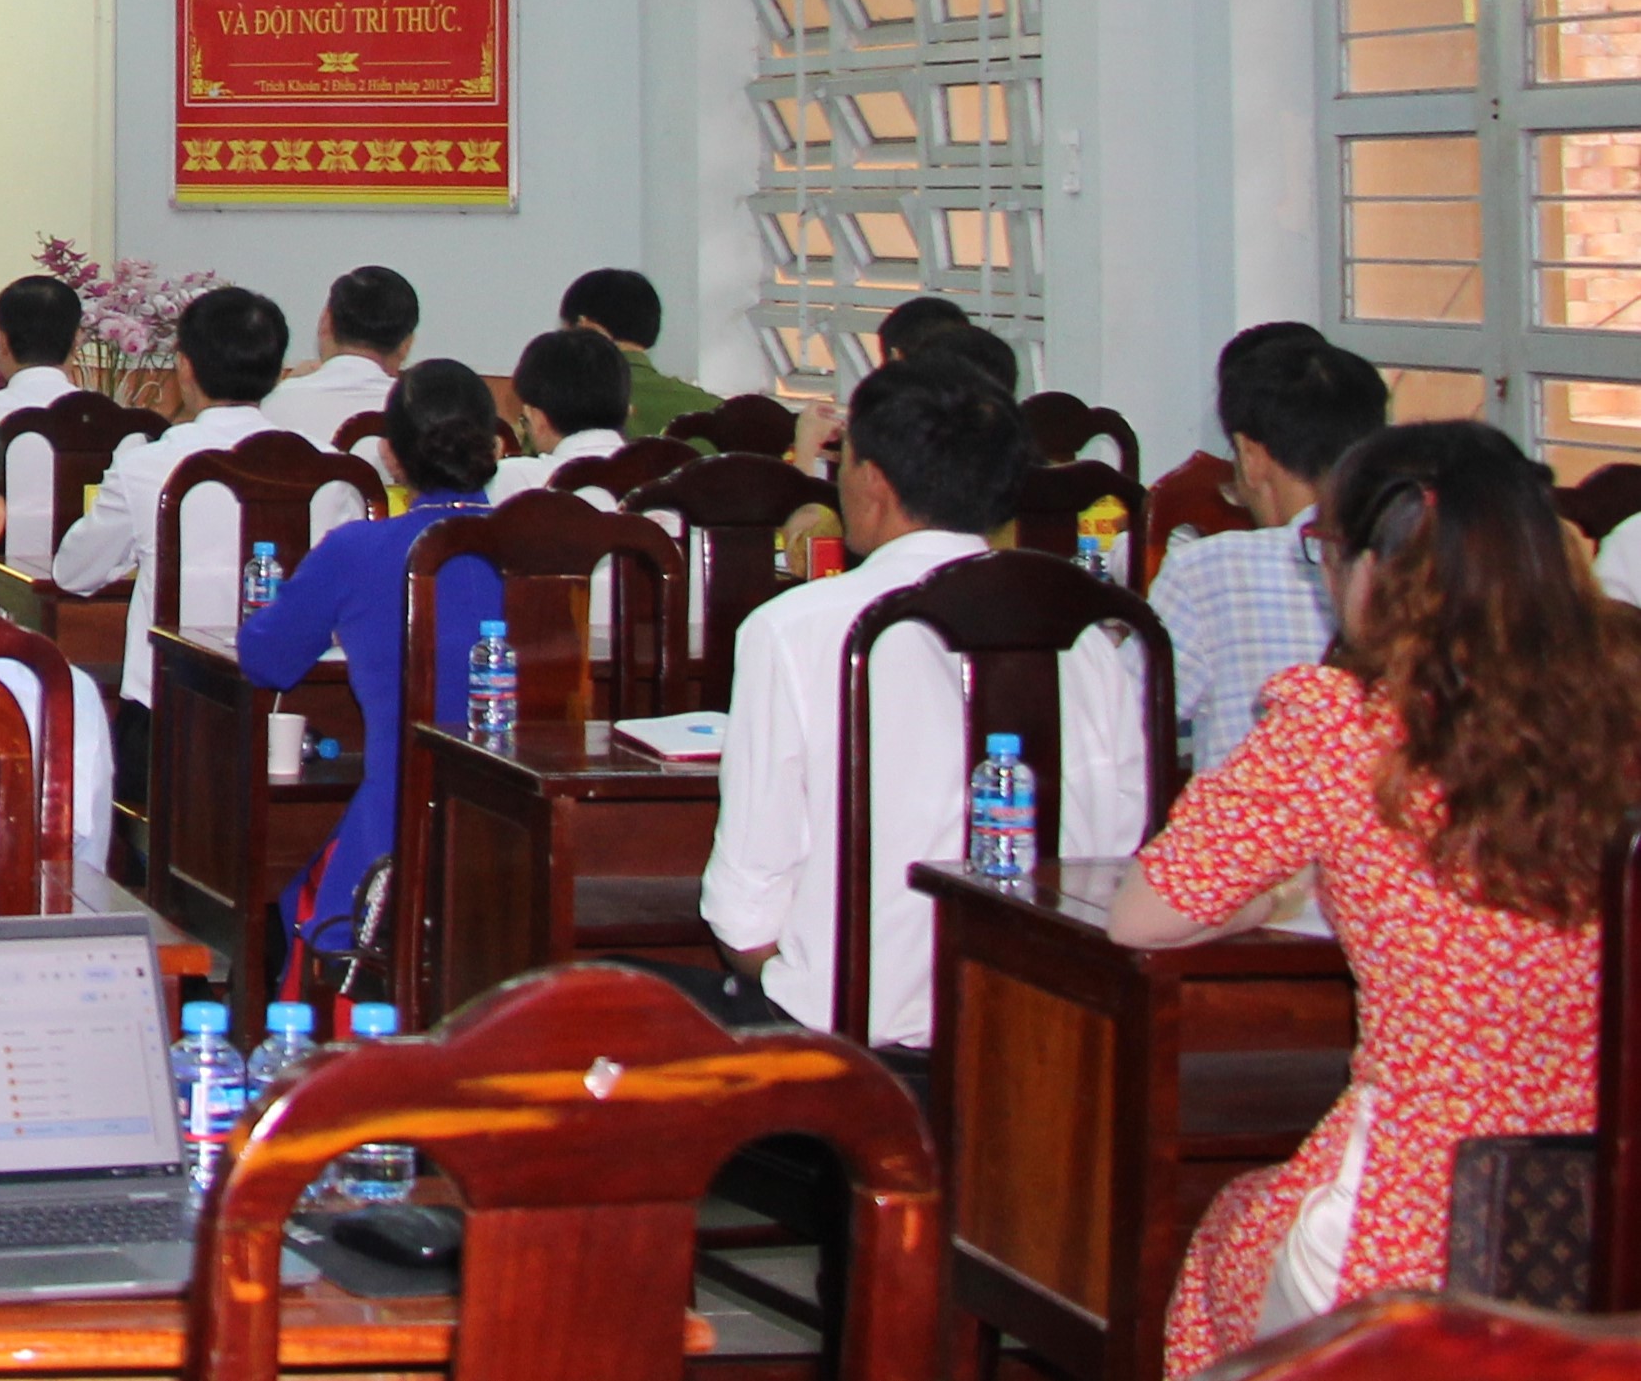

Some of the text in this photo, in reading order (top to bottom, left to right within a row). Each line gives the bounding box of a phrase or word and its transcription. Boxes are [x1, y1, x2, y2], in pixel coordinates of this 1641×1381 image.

[217, 3, 249, 35] VÀ
[254, 5, 294, 39] ĐỘI
[298, 2, 347, 35] NGŨ
[351, 0, 388, 33] TRÍ
